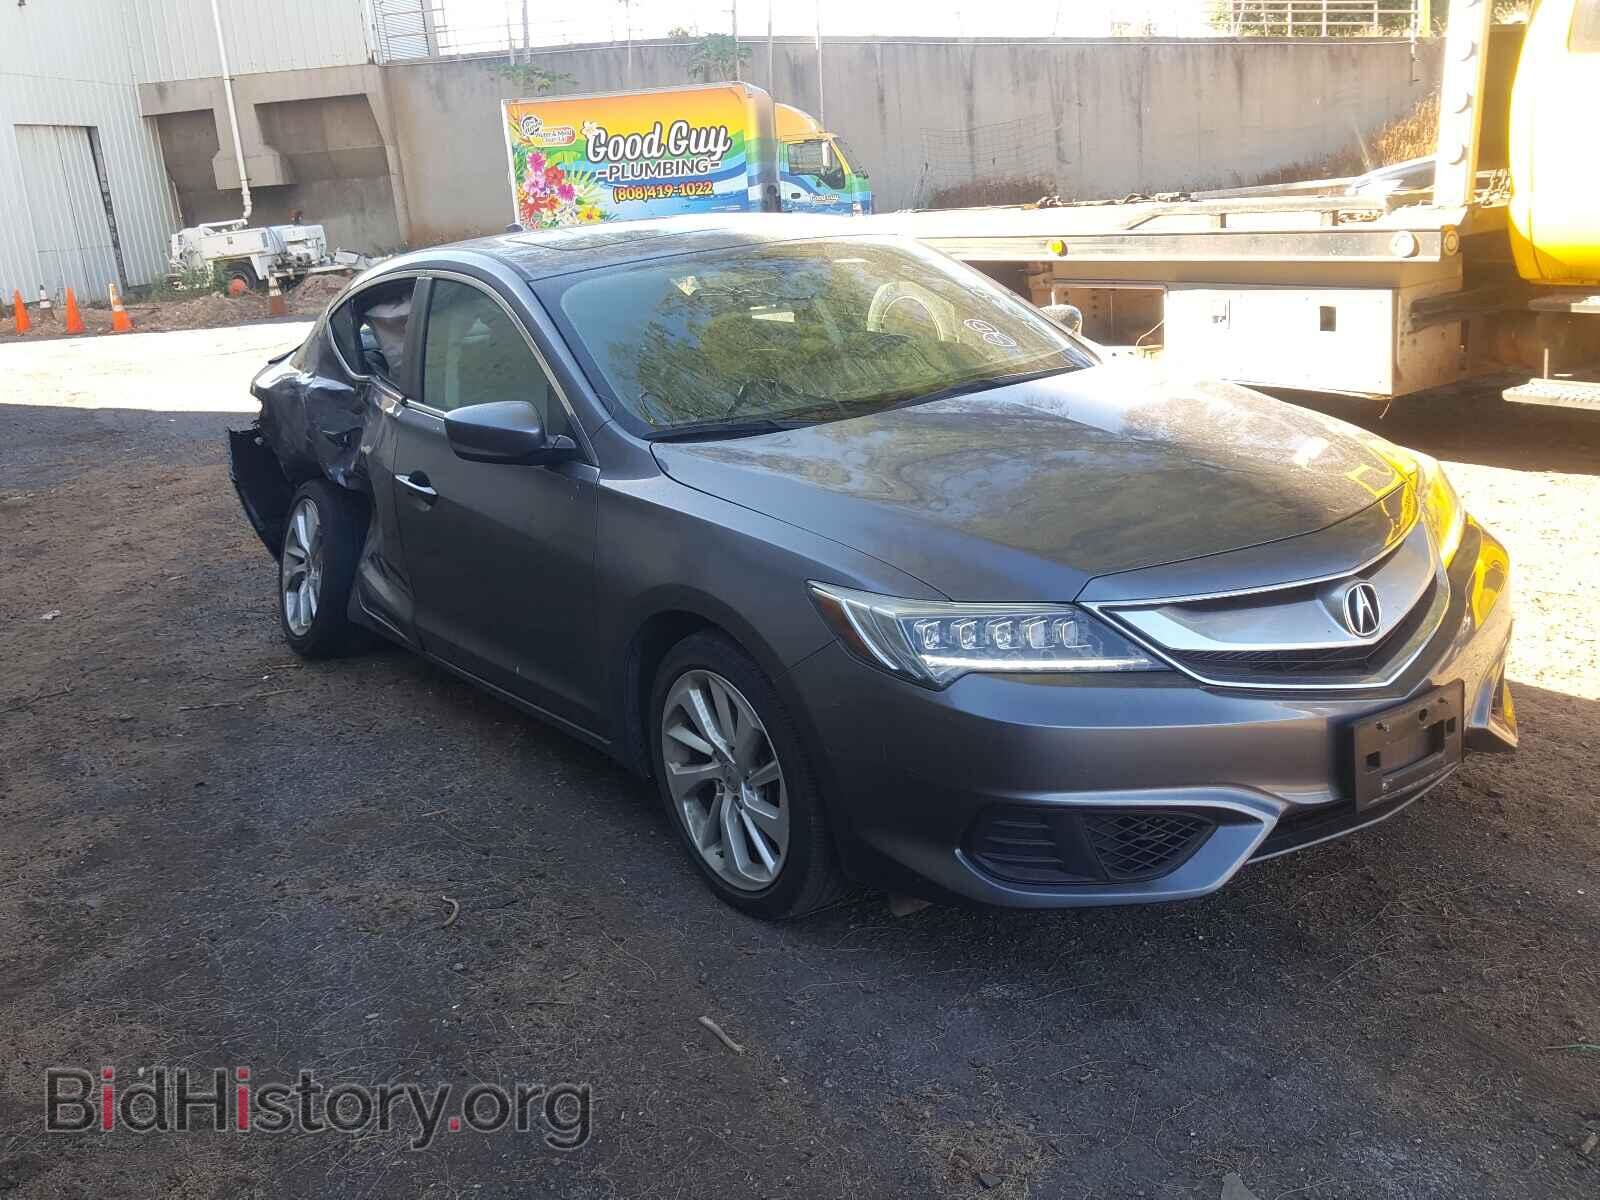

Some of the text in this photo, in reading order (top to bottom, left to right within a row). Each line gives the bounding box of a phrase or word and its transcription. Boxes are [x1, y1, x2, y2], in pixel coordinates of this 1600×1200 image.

[586, 121, 665, 163] Good
[668, 119, 733, 161] Guy
[613, 182, 713, 203] (808)419-1022
